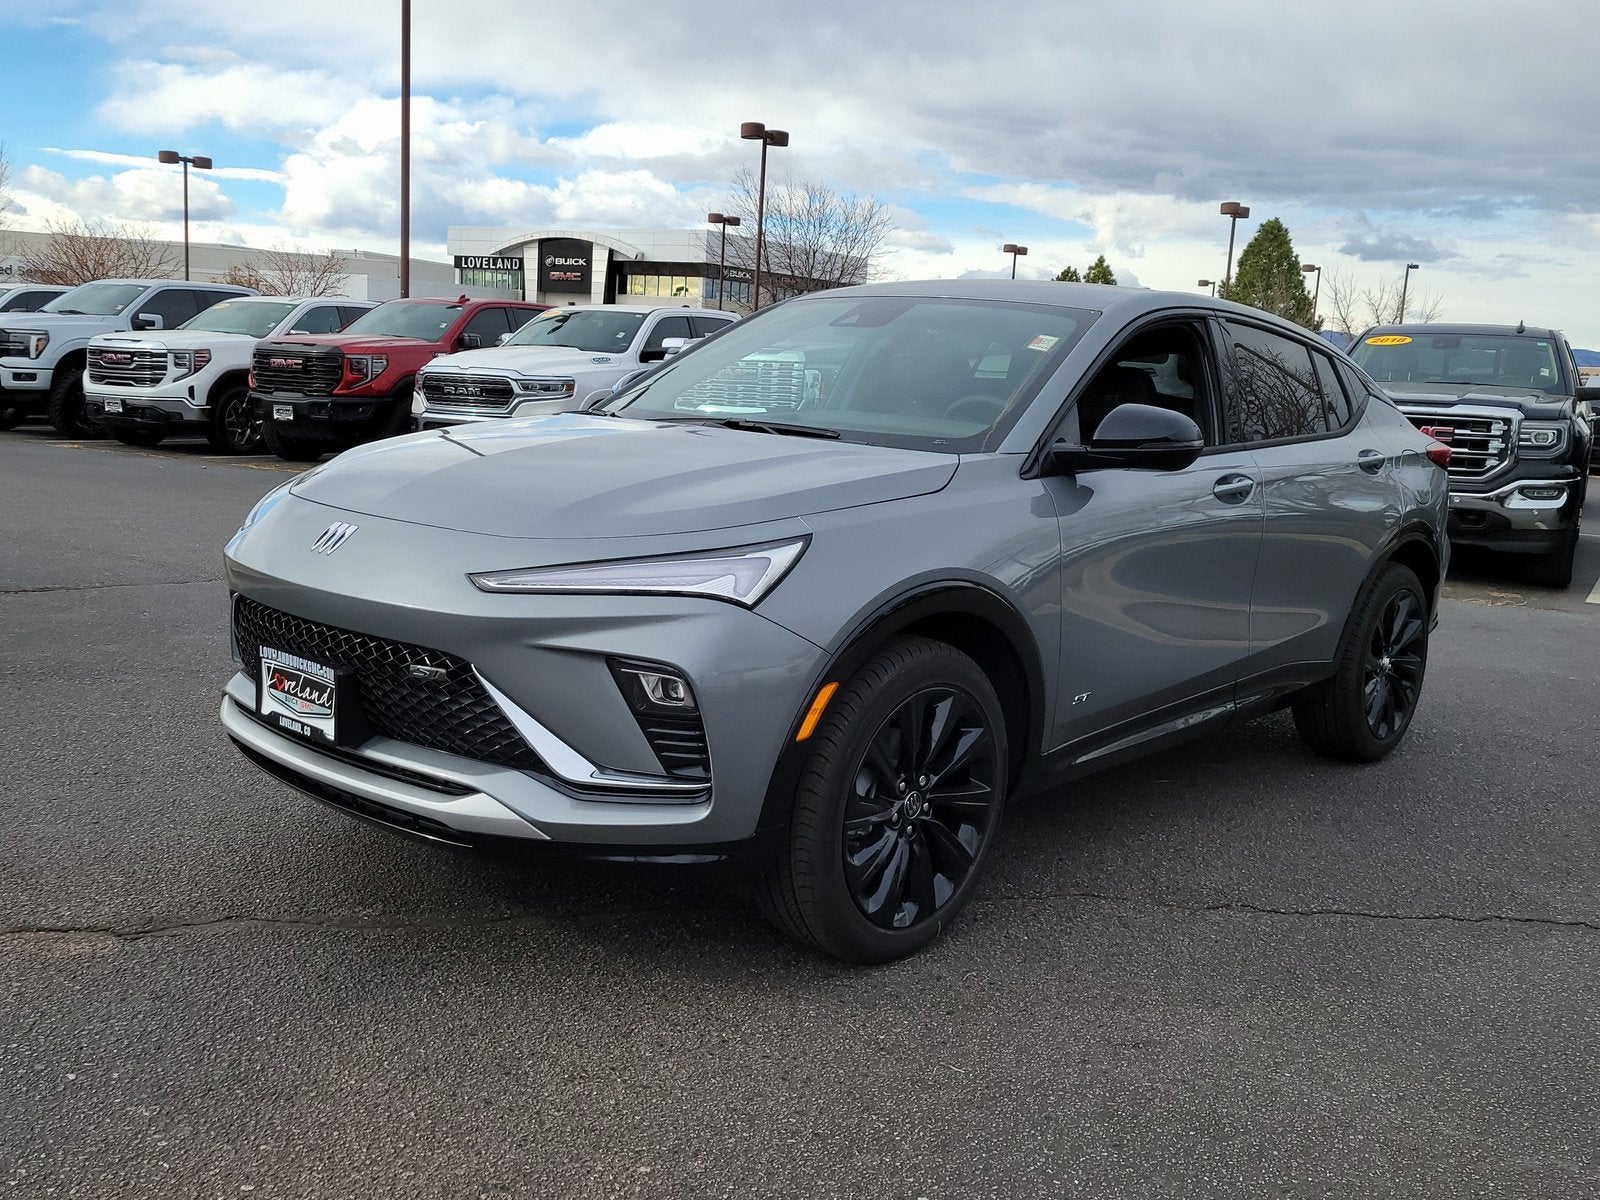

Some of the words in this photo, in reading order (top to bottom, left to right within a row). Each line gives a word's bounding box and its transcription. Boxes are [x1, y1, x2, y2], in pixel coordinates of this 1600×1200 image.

[461, 256, 520, 270] LOVELAND
[554, 257, 587, 267] BUICK
[549, 271, 582, 281] GMC
[100, 353, 131, 363] GMC
[270, 358, 303, 369] GMC
[443, 386, 481, 396] RAM
[284, 694, 299, 705] BUICK
[300, 700, 314, 711] GMC
[279, 715, 303, 735] LOVELAND,
[303, 725, 311, 737] CO
